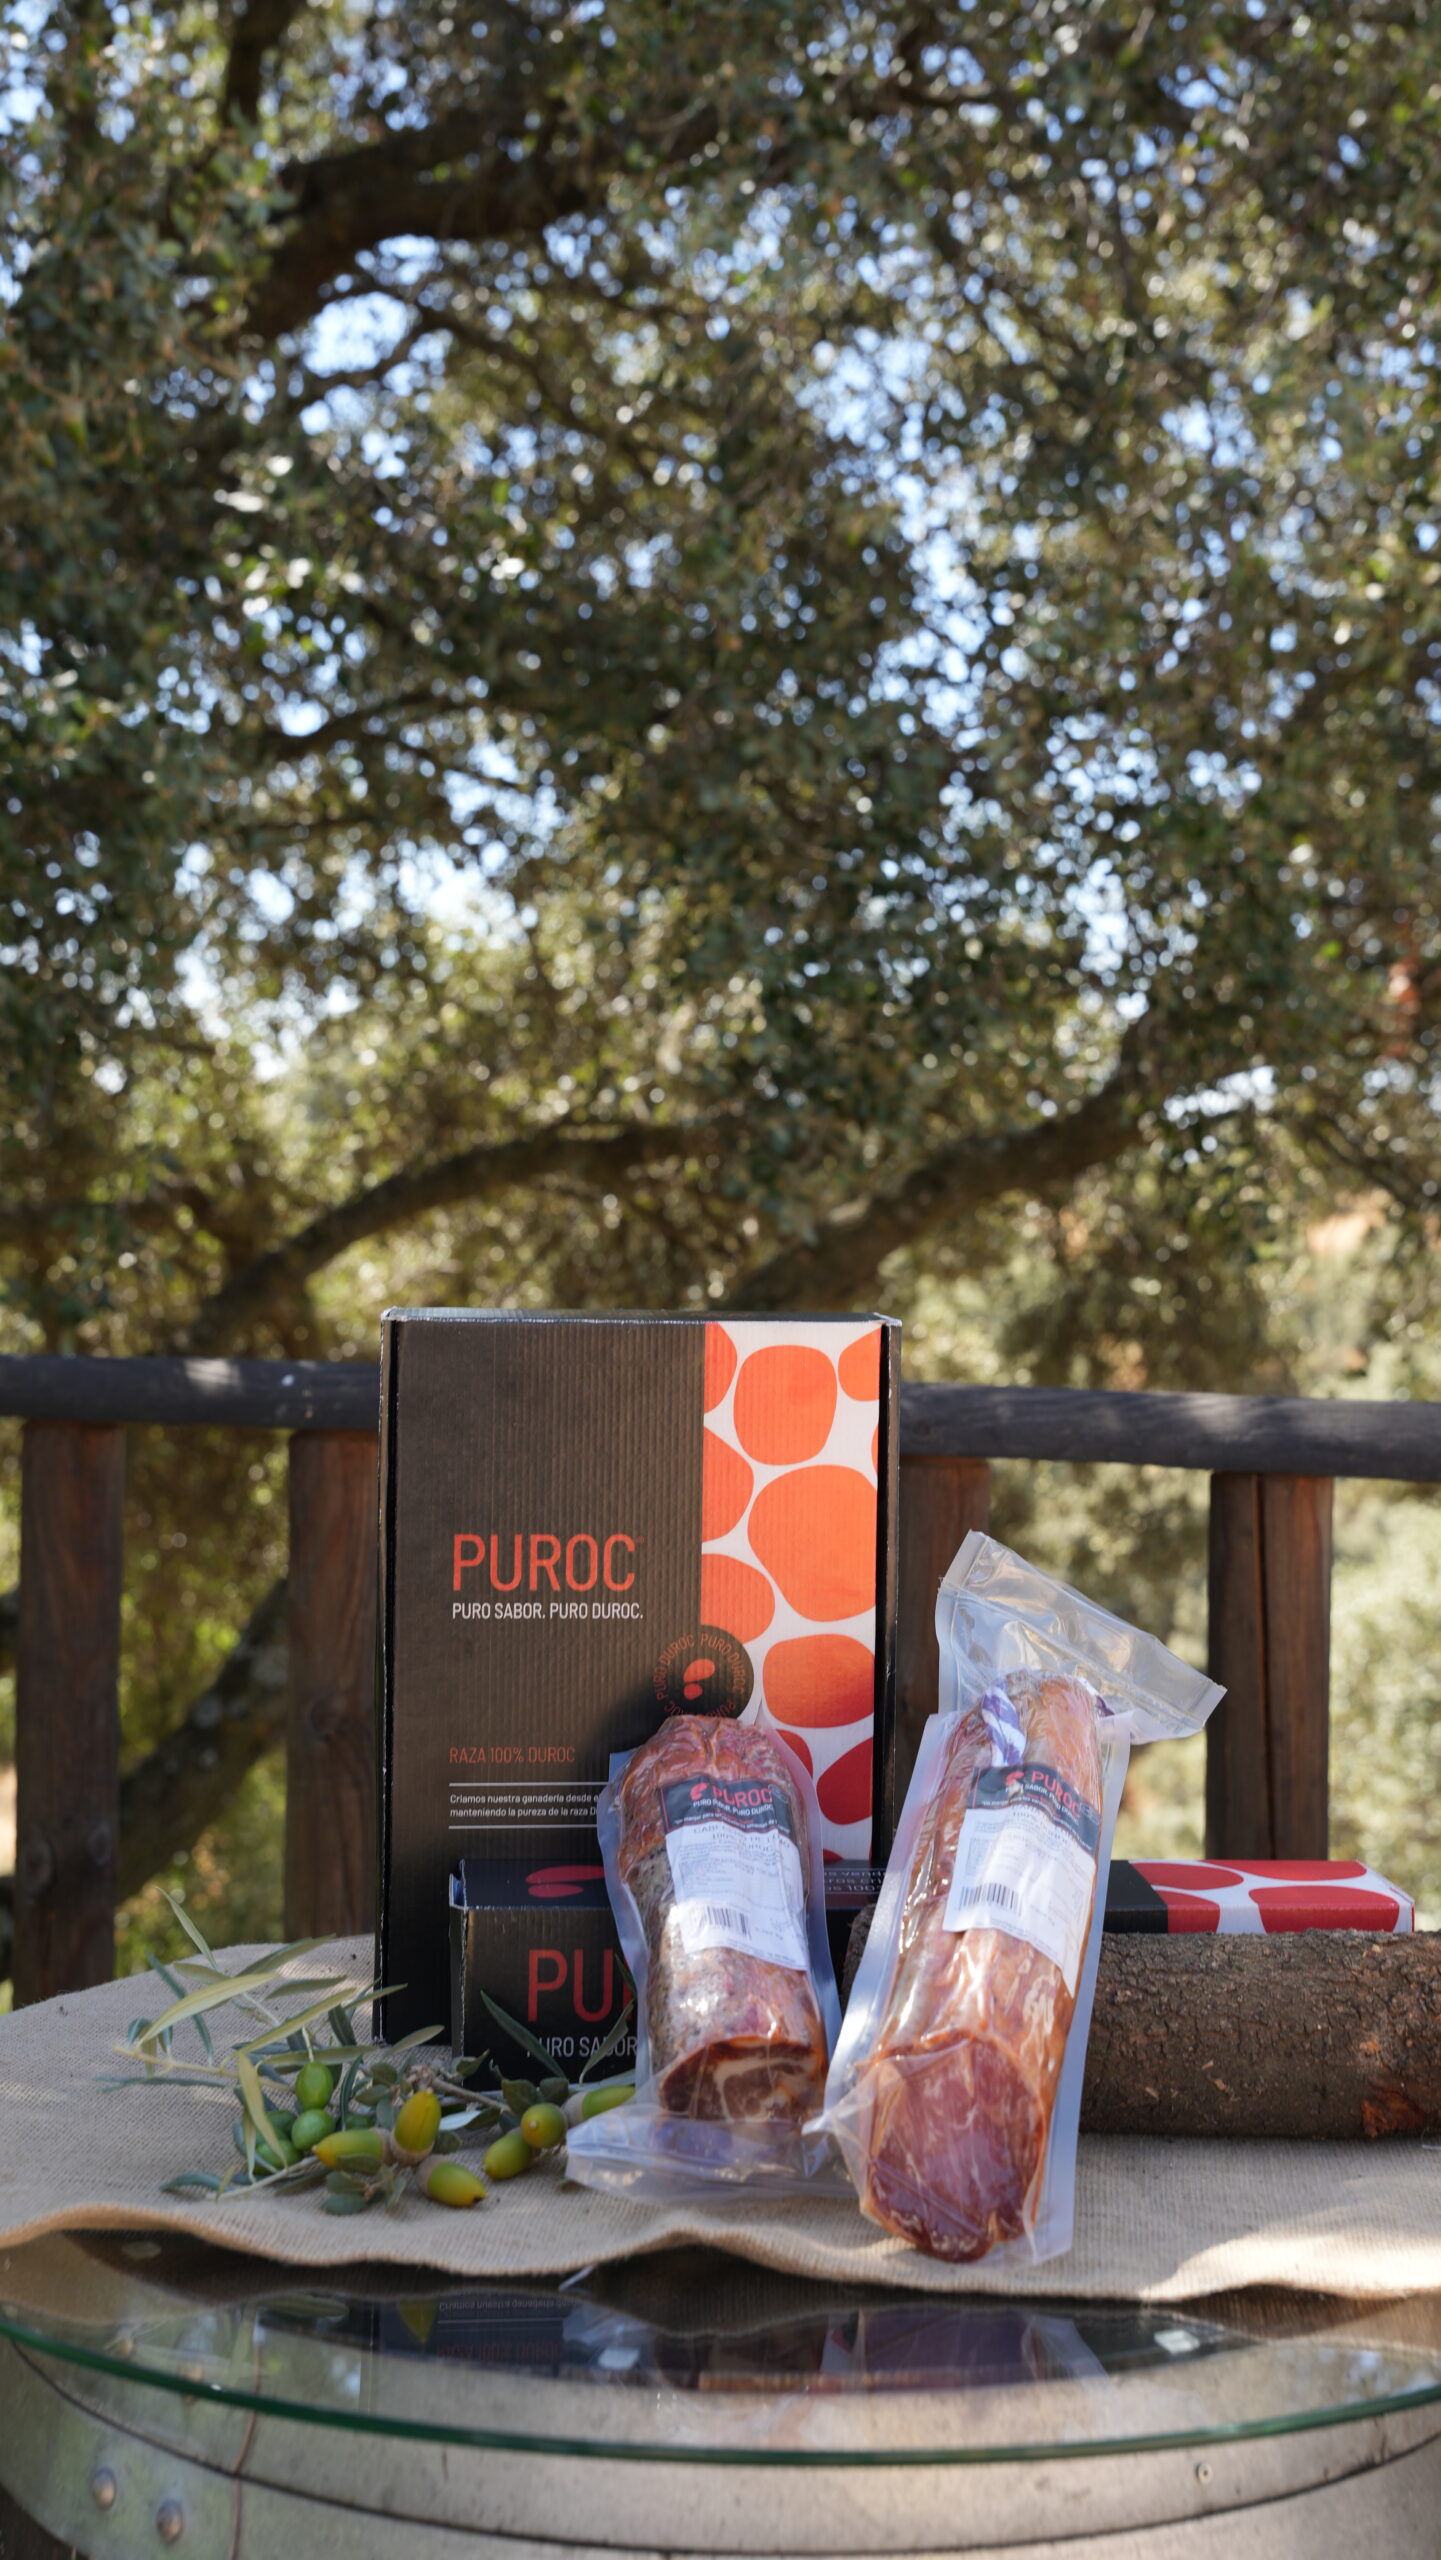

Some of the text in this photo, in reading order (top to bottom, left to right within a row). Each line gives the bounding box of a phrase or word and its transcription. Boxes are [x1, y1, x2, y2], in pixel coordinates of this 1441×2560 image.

[452, 1533, 636, 1592] PUROC
[452, 1602, 644, 1620] PURO SABOR. PURO DUROC.
[700, 1632, 732, 1656] PURO
[449, 1746, 575, 1763] RAZA 100% DUROC
[450, 1794, 486, 1804] Criamos
[487, 1794, 520, 1803] nuestra
[565, 1793, 592, 1803] desde
[450, 1807, 507, 1817] manteniendo
[508, 1807, 516, 1816] la
[517, 1807, 547, 1818] pureza
[548, 1807, 559, 1816] de
[560, 1806, 569, 1816] la
[569, 1807, 588, 1816] raza
